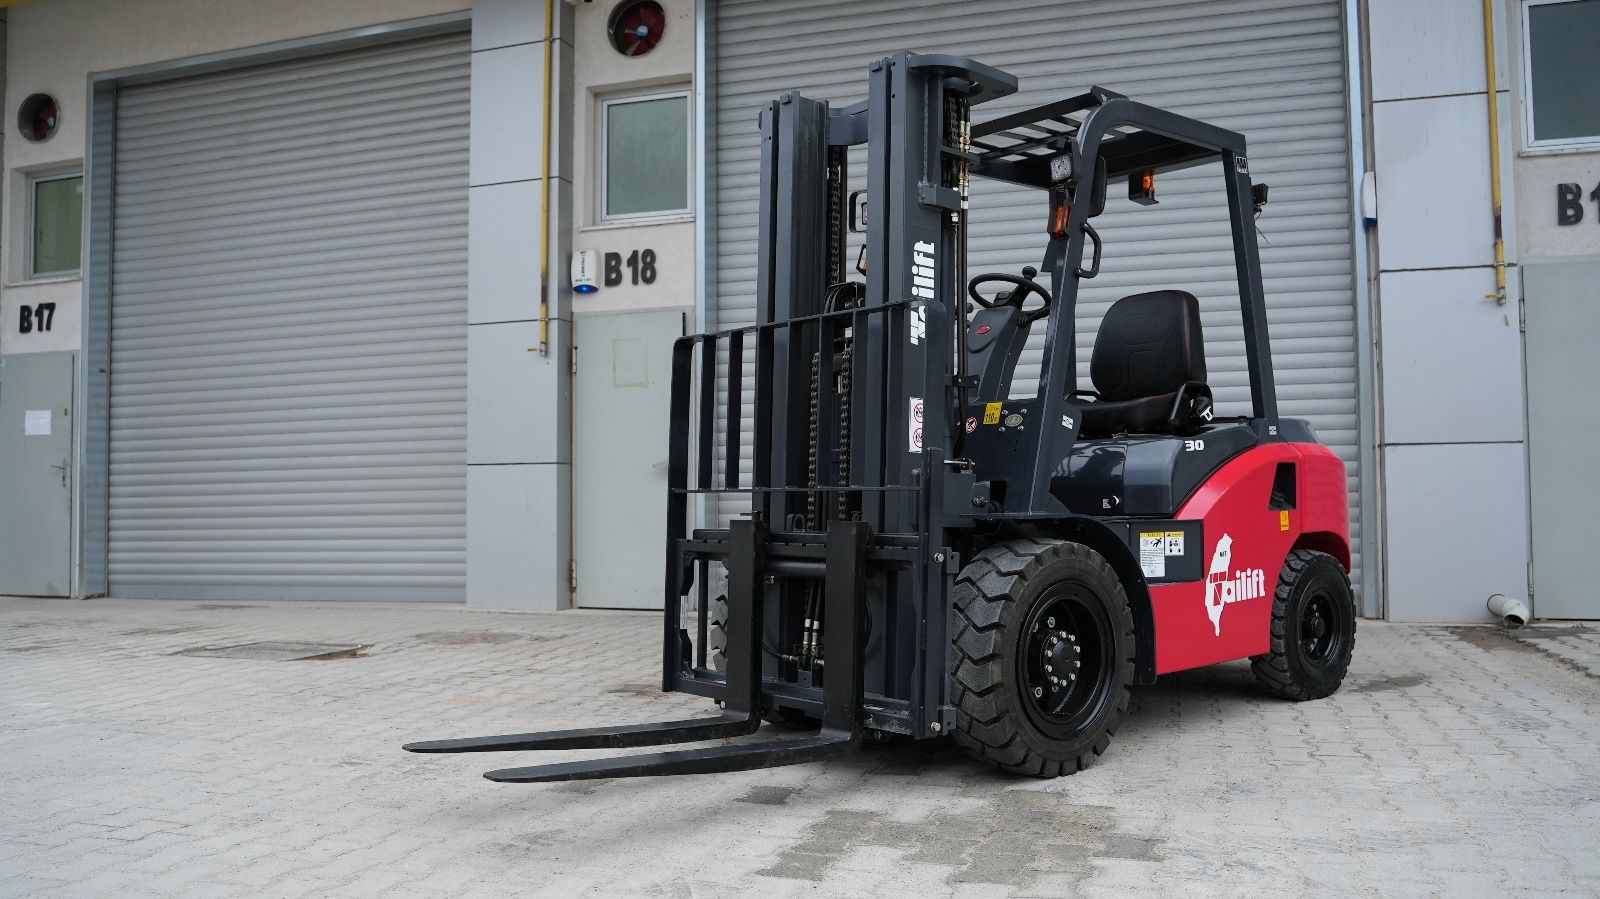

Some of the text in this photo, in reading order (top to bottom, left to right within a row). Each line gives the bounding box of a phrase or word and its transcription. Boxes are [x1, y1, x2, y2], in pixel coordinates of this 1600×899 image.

[604, 248, 657, 287] B18
[19, 302, 56, 334] B17
[1184, 439, 1205, 452] 30
